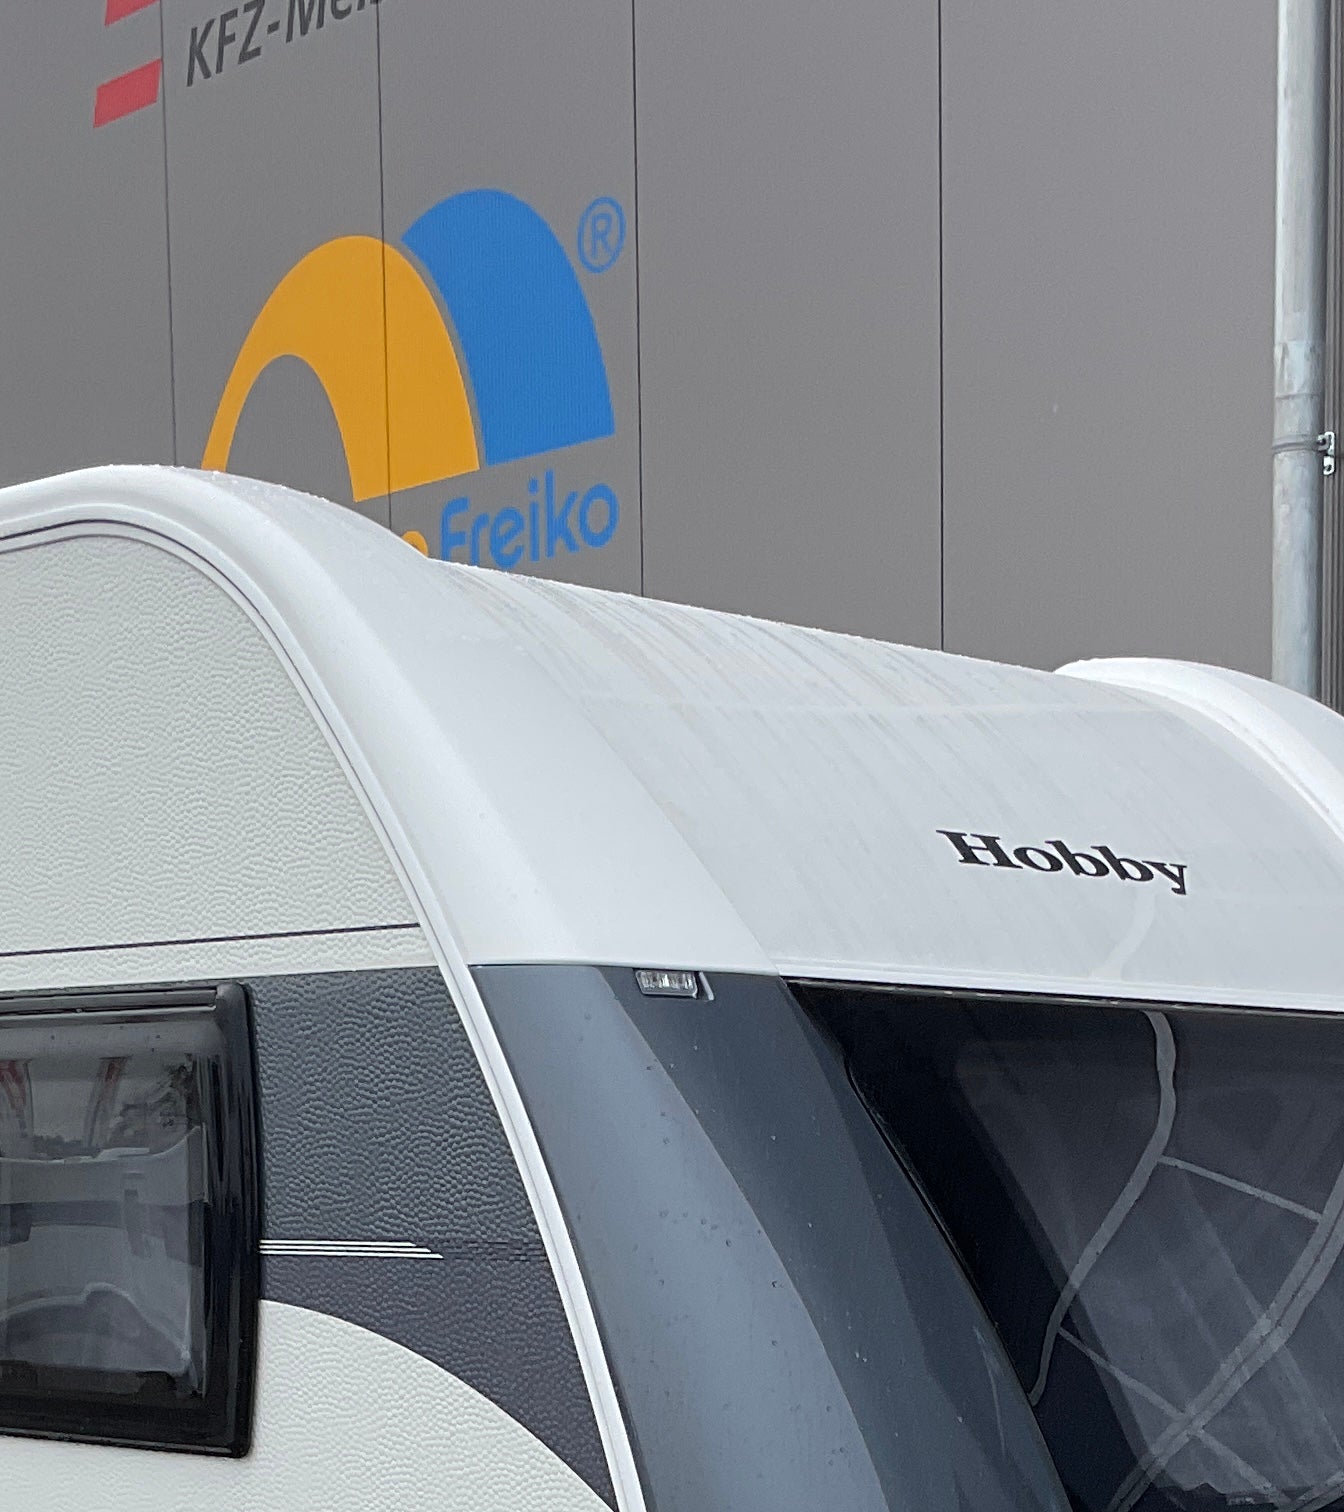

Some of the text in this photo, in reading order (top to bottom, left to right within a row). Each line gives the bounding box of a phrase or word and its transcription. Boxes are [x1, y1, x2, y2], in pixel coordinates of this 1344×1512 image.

[186, 0, 382, 87] KFZ-M
[440, 469, 620, 570] Freiko
[936, 829, 1188, 896] Hobby
